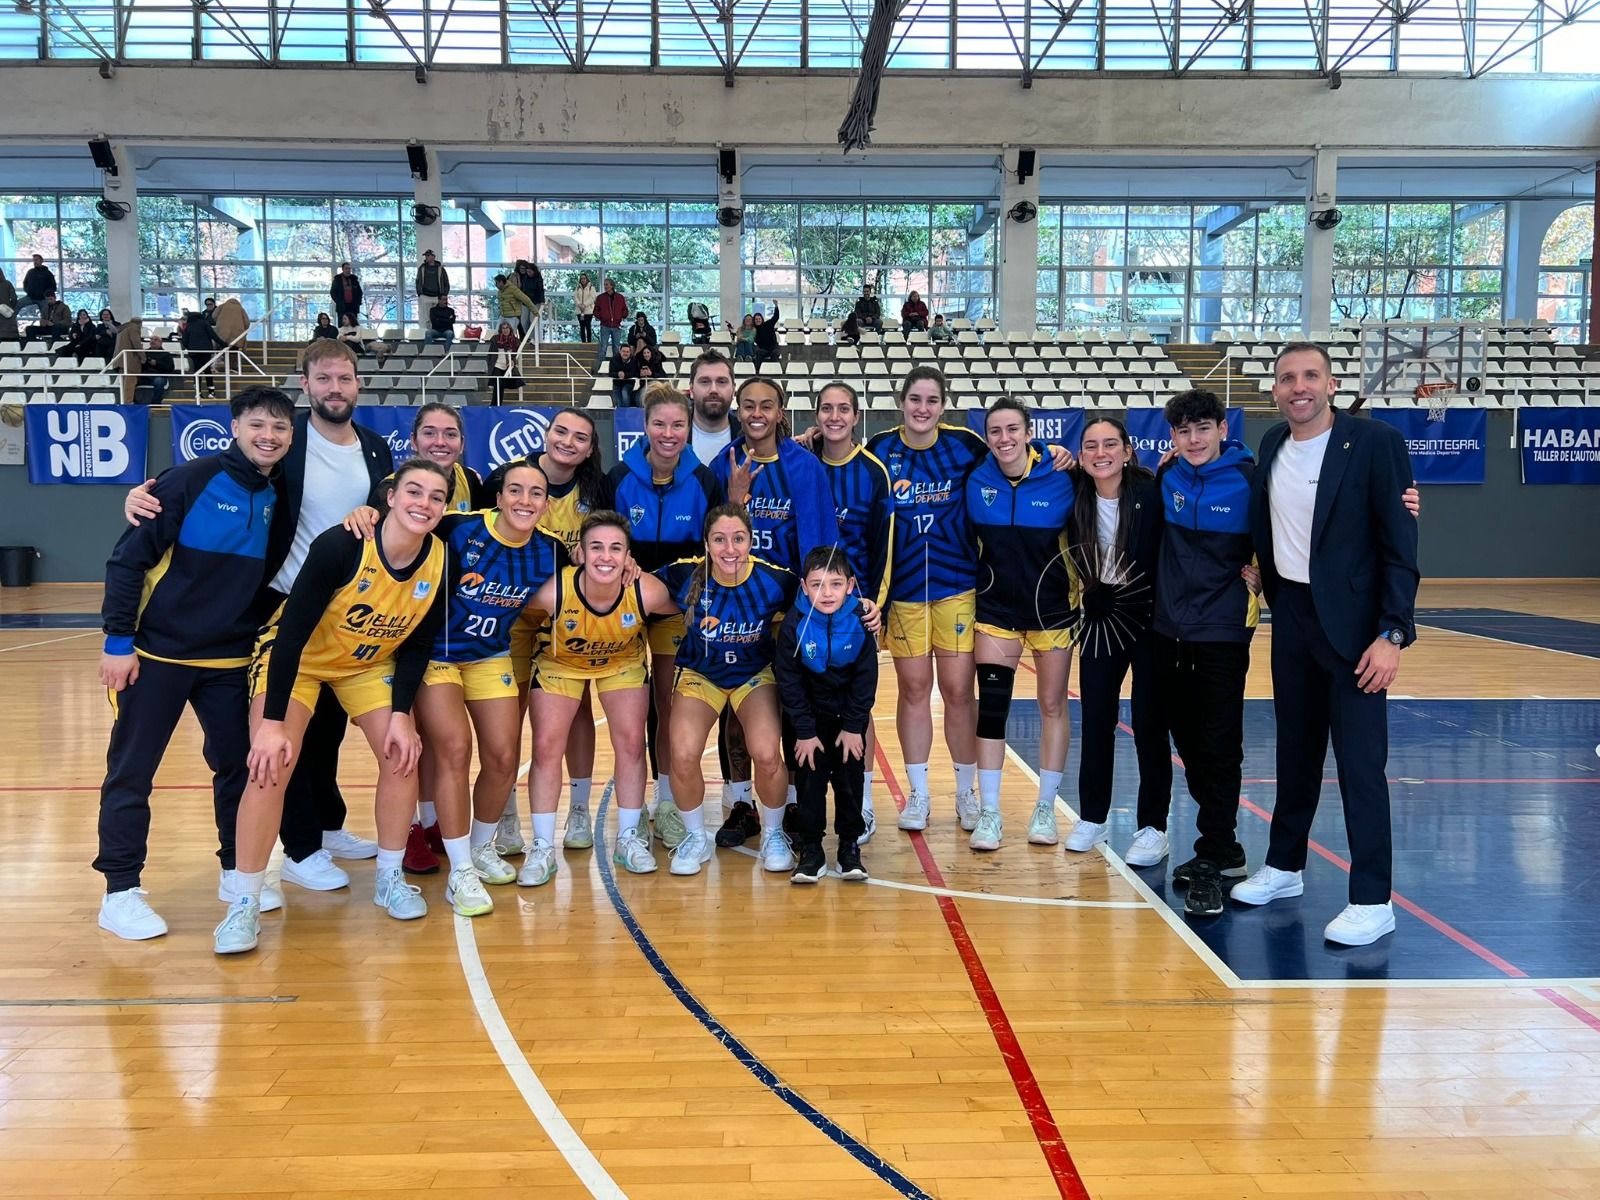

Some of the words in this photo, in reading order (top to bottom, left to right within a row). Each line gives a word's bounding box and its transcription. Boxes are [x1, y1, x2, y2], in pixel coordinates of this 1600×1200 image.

[500, 423, 542, 461] ETC
[1534, 450, 1559, 461] TALLER
[1560, 450, 1569, 461] DE
[217, 502, 238, 513] vive
[1211, 505, 1231, 513] vive
[913, 513, 934, 534] 17
[751, 530, 773, 550] 55
[464, 614, 497, 638] 20
[351, 643, 381, 660] 41
[725, 651, 737, 664] 6
